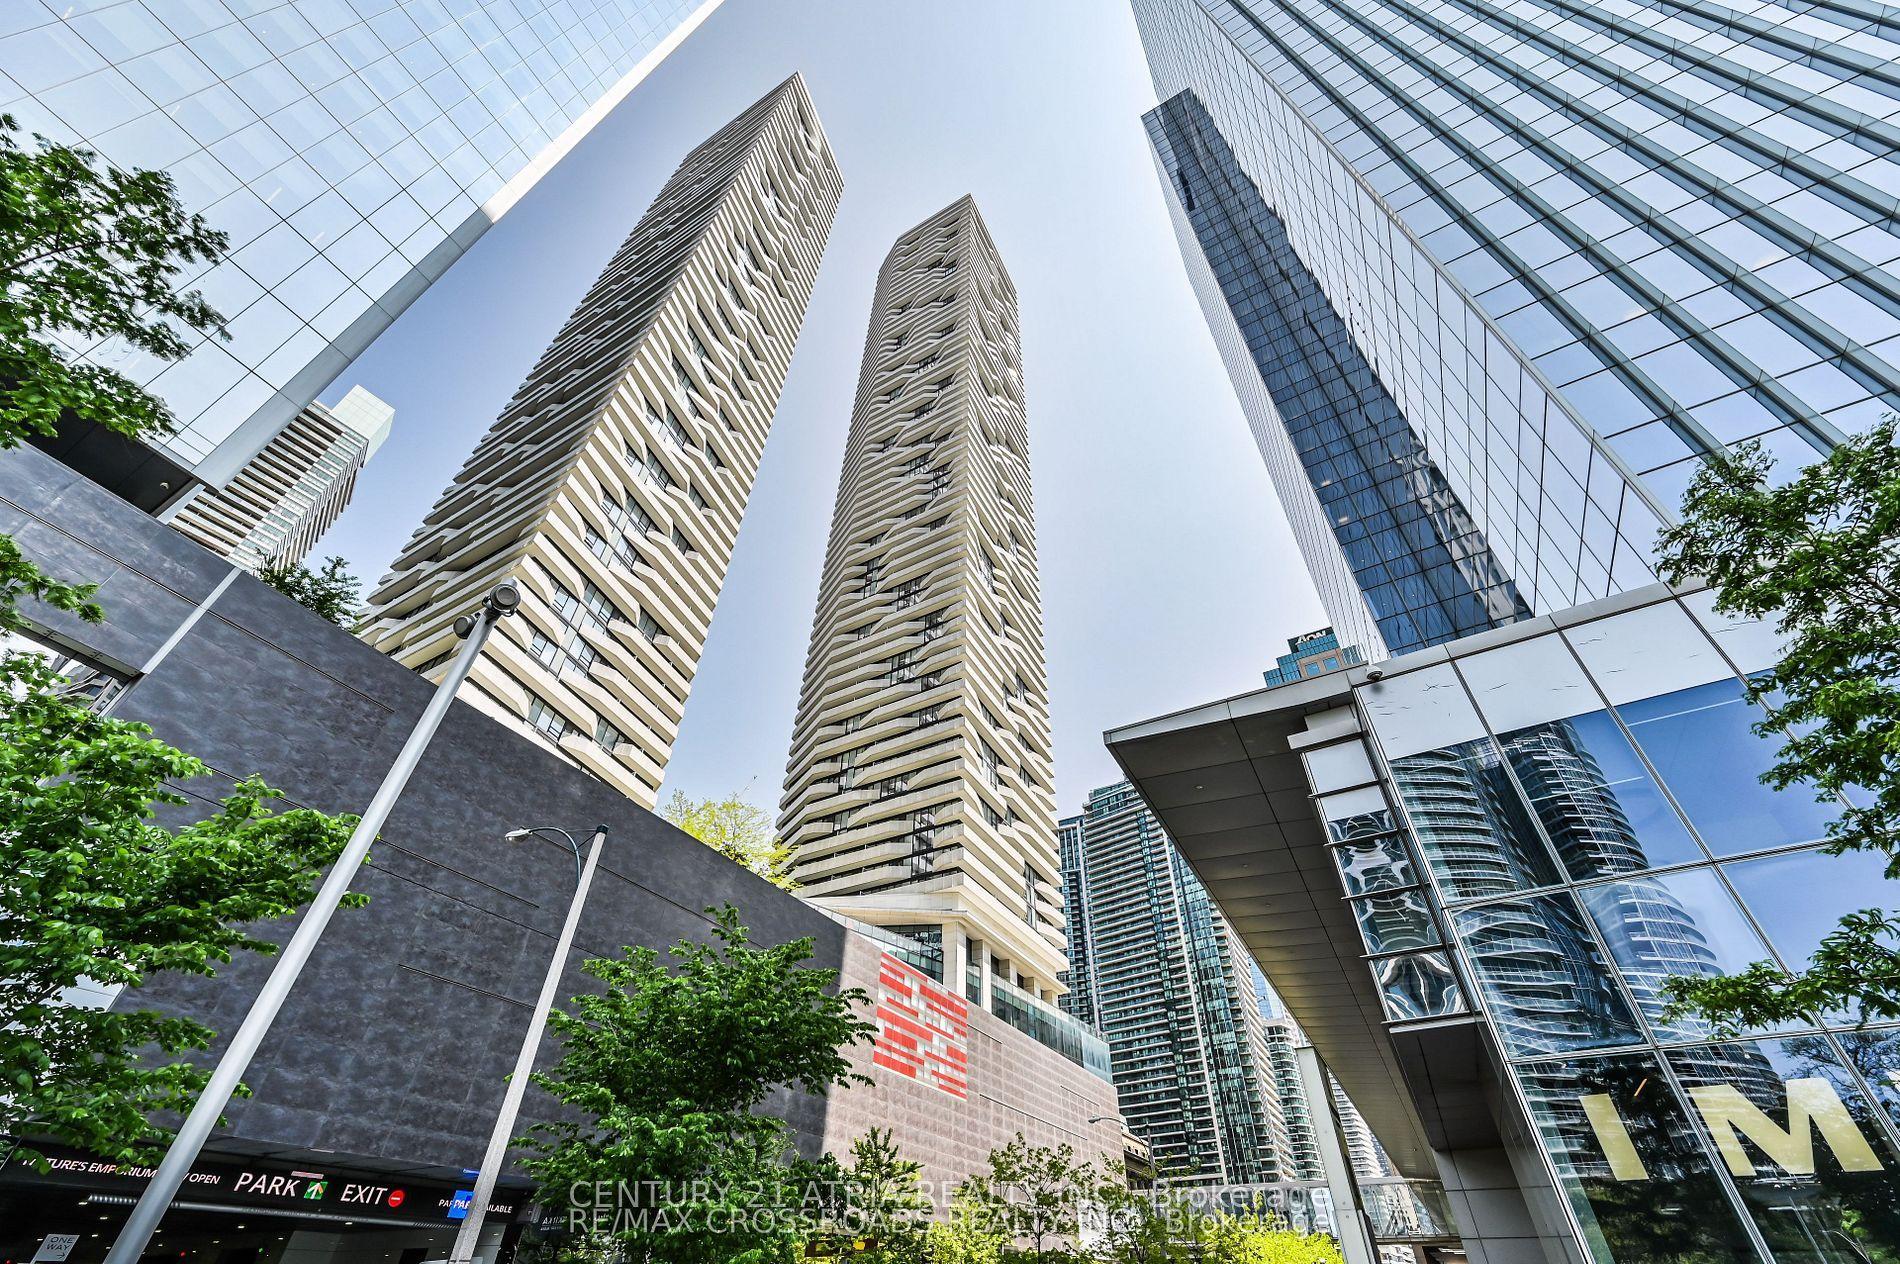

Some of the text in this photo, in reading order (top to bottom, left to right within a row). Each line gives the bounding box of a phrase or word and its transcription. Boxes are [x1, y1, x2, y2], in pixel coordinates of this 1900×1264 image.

[22, 1157, 89, 1172] NTURE'S
[189, 1173, 221, 1185] OPEN
[233, 1172, 300, 1198] PARK
[340, 1184, 388, 1205] EXIT
[46, 1243, 71, 1251] WAY
[50, 1236, 73, 1244] ONE
